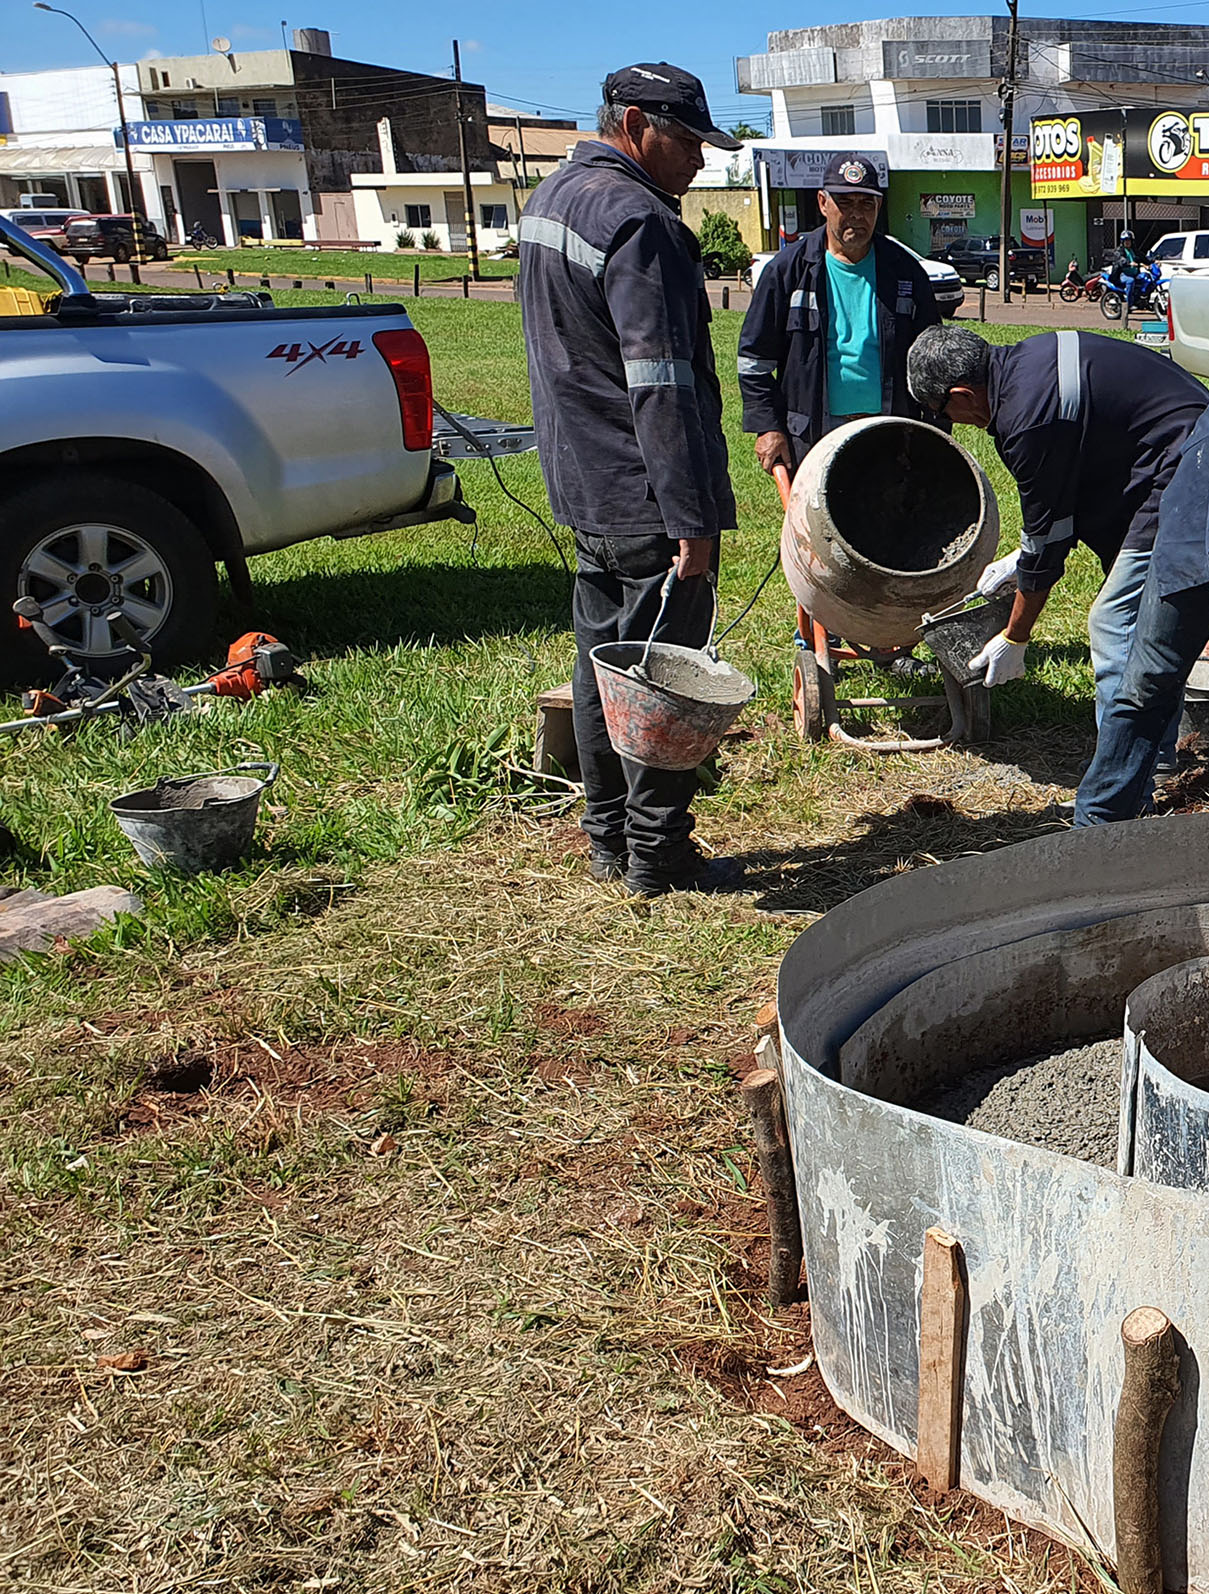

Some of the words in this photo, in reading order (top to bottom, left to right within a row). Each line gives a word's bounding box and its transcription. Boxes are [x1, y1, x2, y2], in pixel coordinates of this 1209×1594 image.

[914, 54, 971, 63] SCOTT
[141, 125, 174, 144] CASA
[1058, 184, 1070, 192] 969
[935, 195, 974, 203] COYOTE
